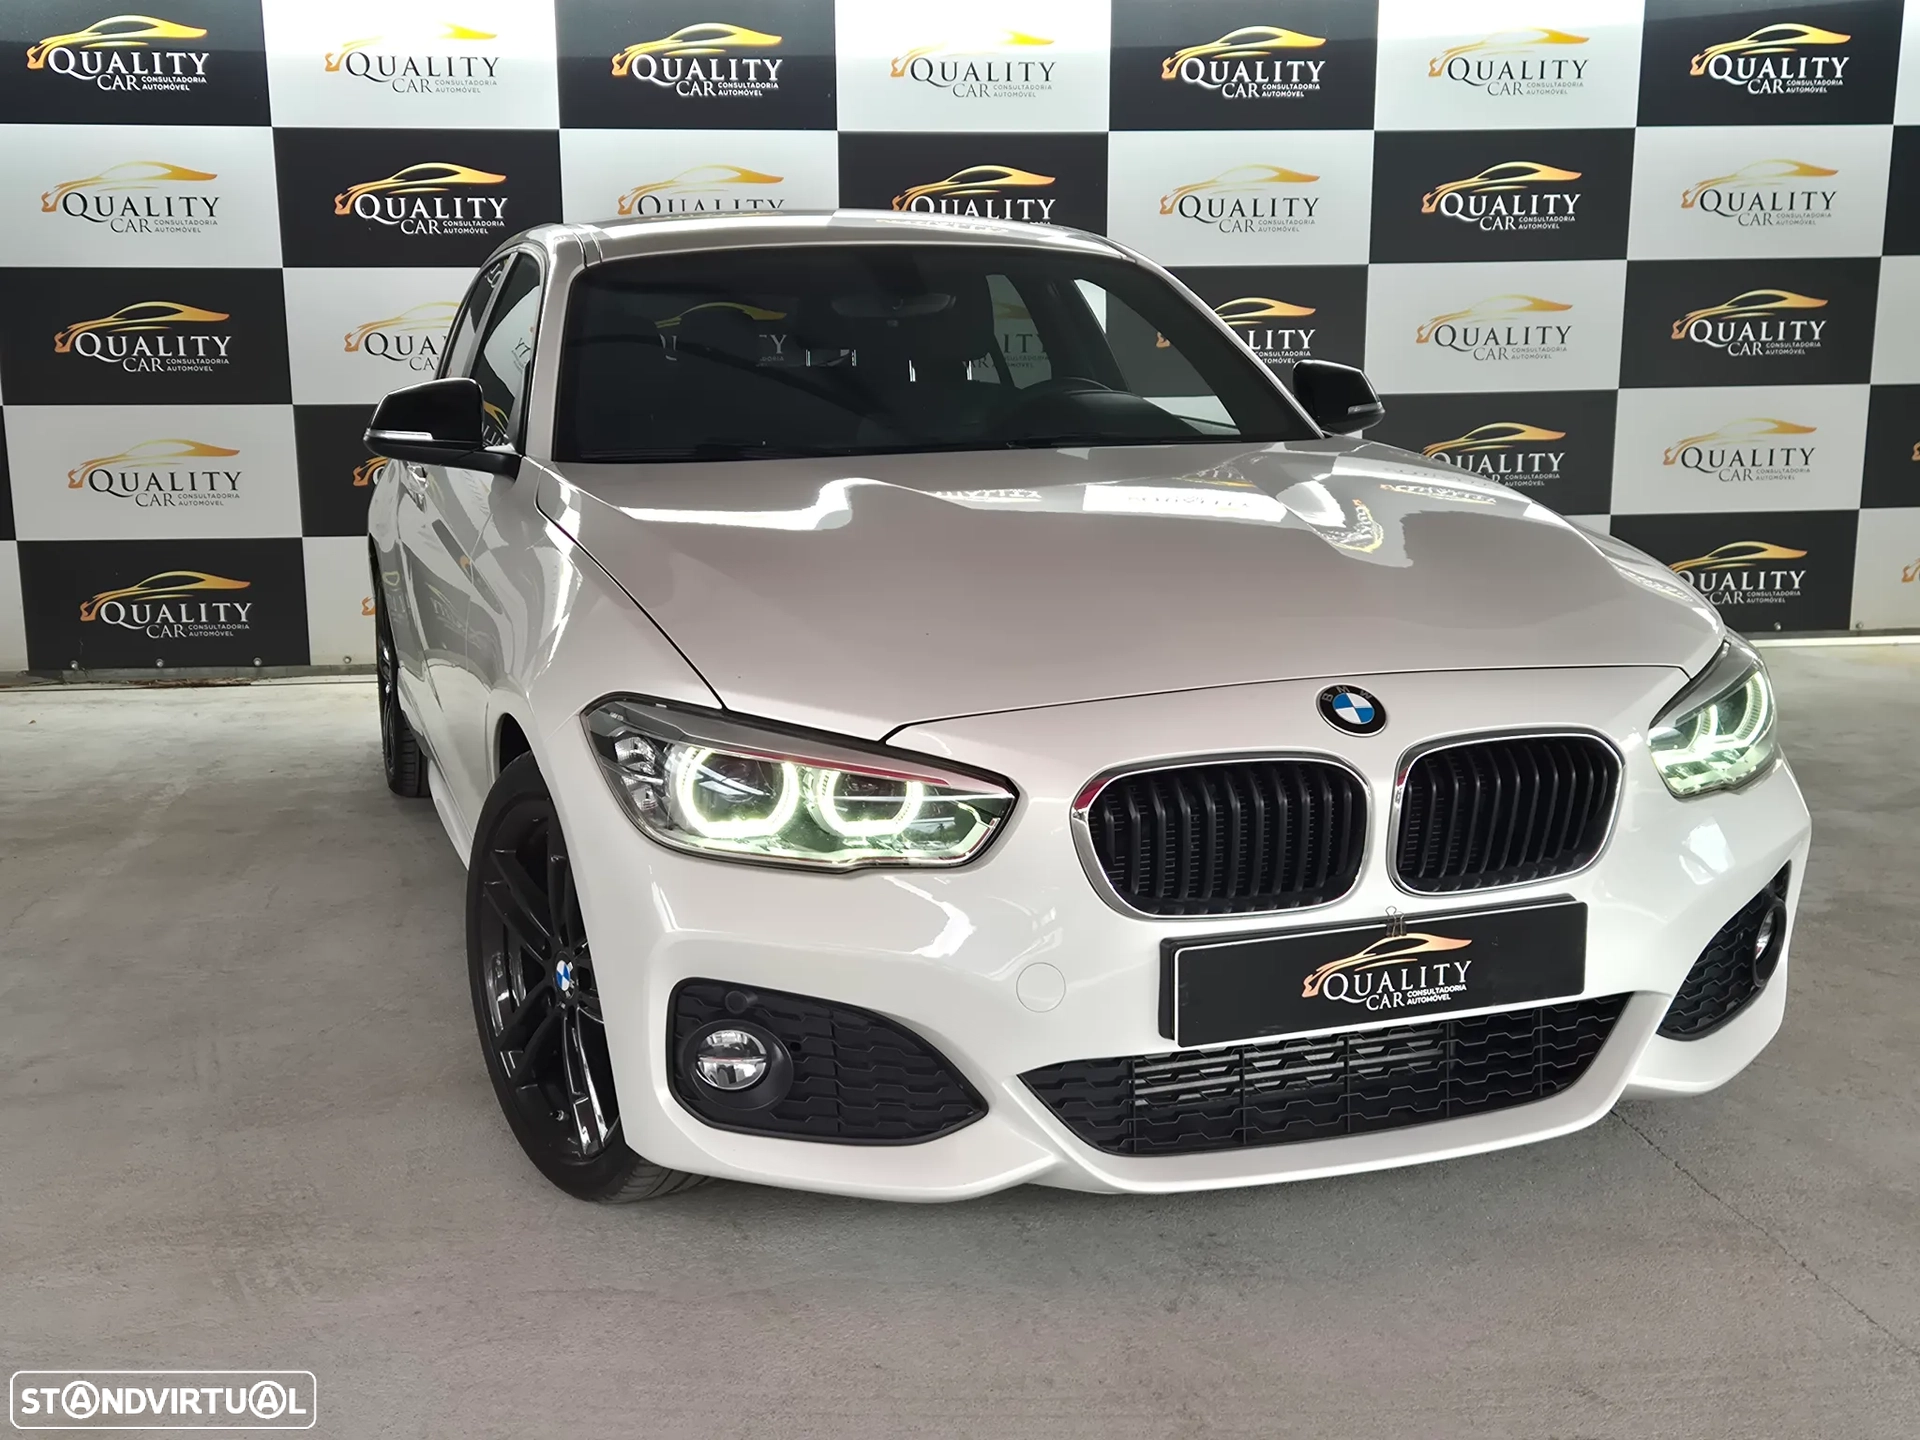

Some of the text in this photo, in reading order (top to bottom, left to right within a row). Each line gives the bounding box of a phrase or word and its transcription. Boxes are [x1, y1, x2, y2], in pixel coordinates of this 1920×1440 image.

[47, 47, 209, 80] QUALITY
[345, 51, 500, 81] QUALITY
[631, 54, 783, 87] QUALITY
[1447, 56, 1589, 87] QUALITY
[1708, 54, 1850, 84] QUALITY
[142, 75, 207, 85] CONSULTADORIA
[911, 57, 1056, 87] QUALITY
[1180, 58, 1326, 88] QUALITY
[96, 75, 140, 92] CAR
[392, 78, 432, 94] CAR
[676, 80, 715, 97] CAR
[718, 81, 779, 89] CONSULTADORIA
[1222, 81, 1260, 98] CAR
[1262, 82, 1320, 90] CONSULTADORIA
[1486, 80, 1524, 96] CAR
[1526, 80, 1584, 88] CONSULTADORIA
[1748, 78, 1785, 94] CAR
[1787, 78, 1844, 86] CONSULTADORIA
[953, 83, 991, 98] CAR
[62, 191, 220, 222] QUALITY
[354, 193, 508, 224] QUALITY
[1178, 194, 1320, 223] QUALITY
[1439, 192, 1580, 222] QUALITY
[1699, 188, 1838, 218] QUALITY
[110, 218, 152, 234] CAR
[154, 218, 218, 226] CONSULTADORIA
[400, 219, 441, 235] CAR
[443, 219, 505, 228] CONSULTADORIA
[1219, 216, 1255, 233] CAR
[1258, 217, 1315, 225] CONSULTADORIA
[1479, 215, 1517, 231] CAR
[1518, 215, 1576, 223] CONSULTADORIA
[1737, 211, 1773, 227] CAR
[1249, 329, 1315, 350] LITY
[1434, 324, 1572, 351] QUALITY
[1689, 320, 1827, 347] QUALITY
[76, 332, 231, 362] QUALITY
[1473, 344, 1509, 361] CAR
[1728, 340, 1764, 356] CAR
[123, 357, 164, 372] CAR
[166, 357, 229, 365] CONSULTADORIA
[409, 357, 438, 371] CA
[1681, 447, 1815, 473] QUALITY
[88, 469, 241, 497] QUALITY
[1718, 468, 1753, 482] CAR
[136, 492, 176, 507] CAR
[178, 492, 240, 500] CONSULTADORIA
[1709, 589, 1744, 604] CAR
[101, 601, 252, 629] QUALITY
[147, 624, 187, 638] CAR
[1322, 686, 1373, 702] BMW
[1323, 961, 1472, 1003] QUALITY
[1407, 984, 1466, 997] CONSULTADORIA
[1366, 993, 1405, 1011] CAR
